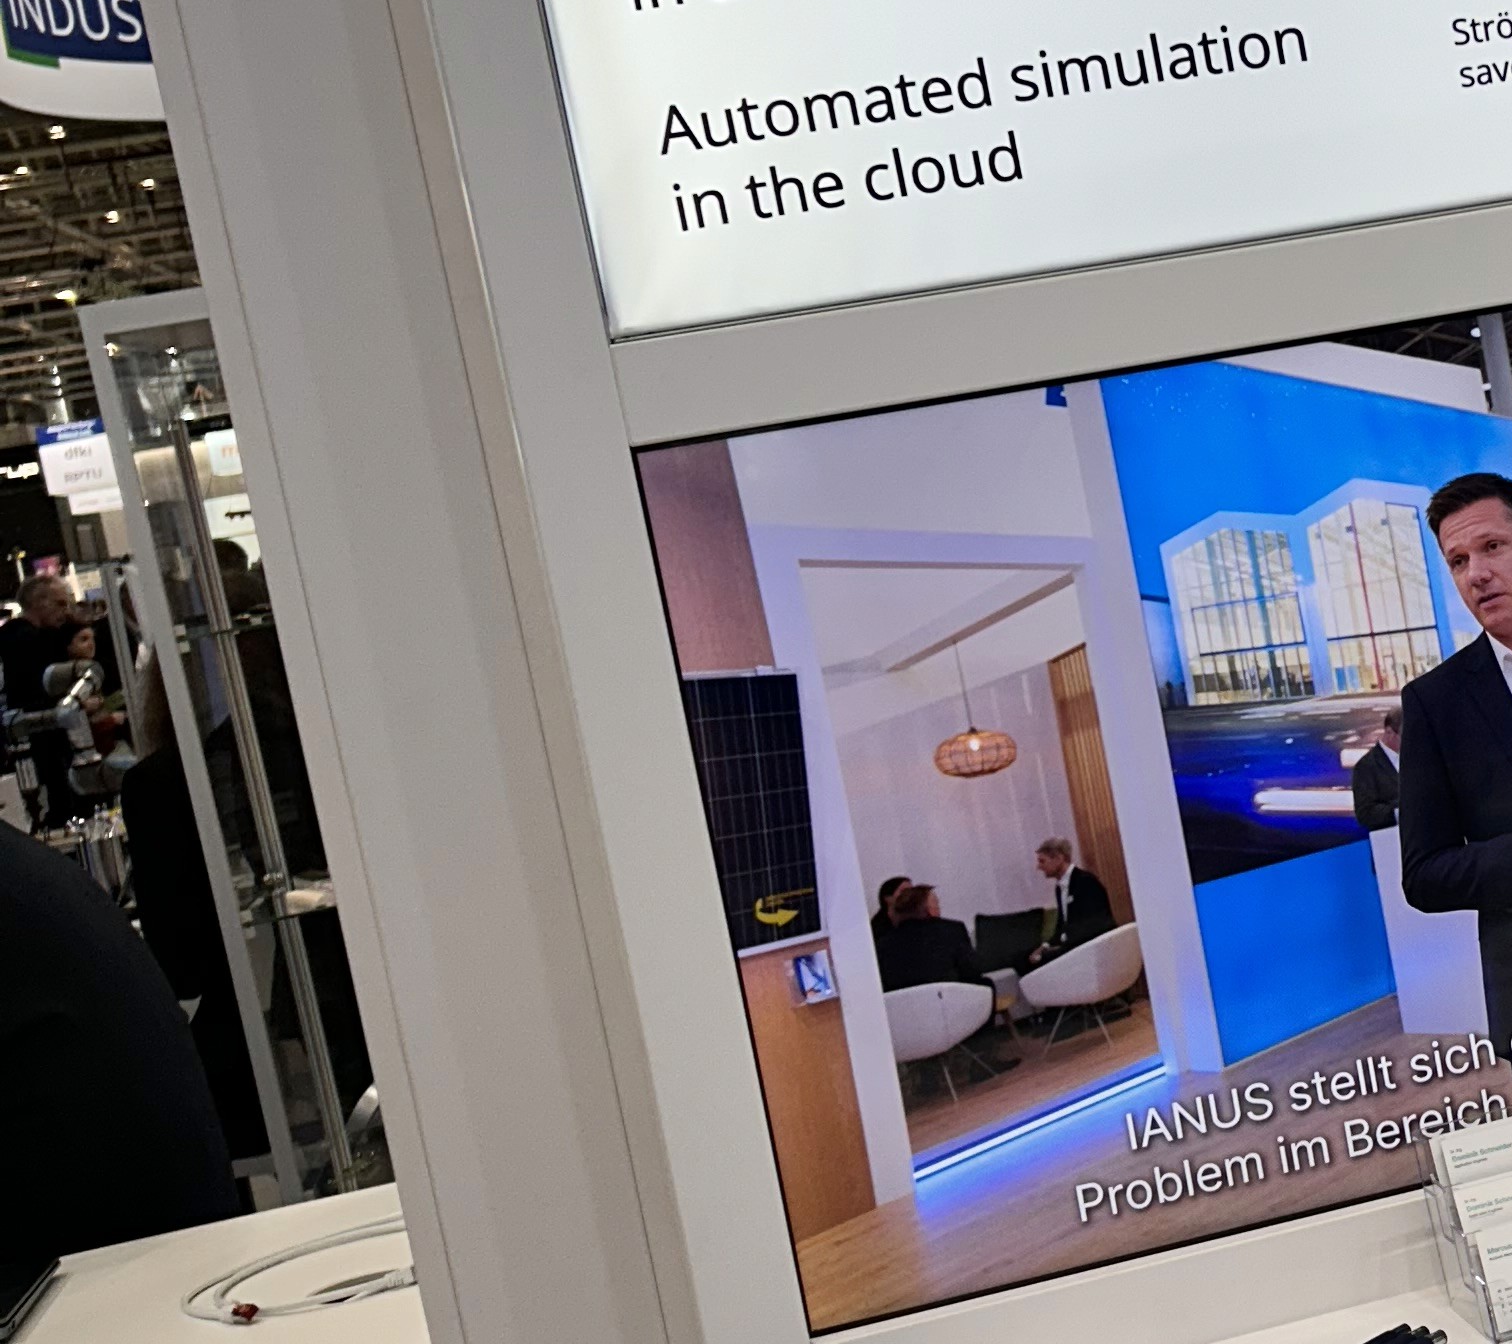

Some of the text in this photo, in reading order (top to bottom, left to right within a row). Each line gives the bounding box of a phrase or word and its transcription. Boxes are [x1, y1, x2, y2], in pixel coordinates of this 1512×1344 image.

[662, 25, 1307, 155] Automated simulation
[673, 131, 1022, 231] in the cloud
[1125, 1082, 1273, 1150] IANUS
[1289, 1056, 1396, 1111] stellt
[1410, 1033, 1496, 1083] sich
[1075, 1149, 1265, 1222] Problem
[1277, 1135, 1330, 1173] im
[1343, 1088, 1507, 1158] Bereich
